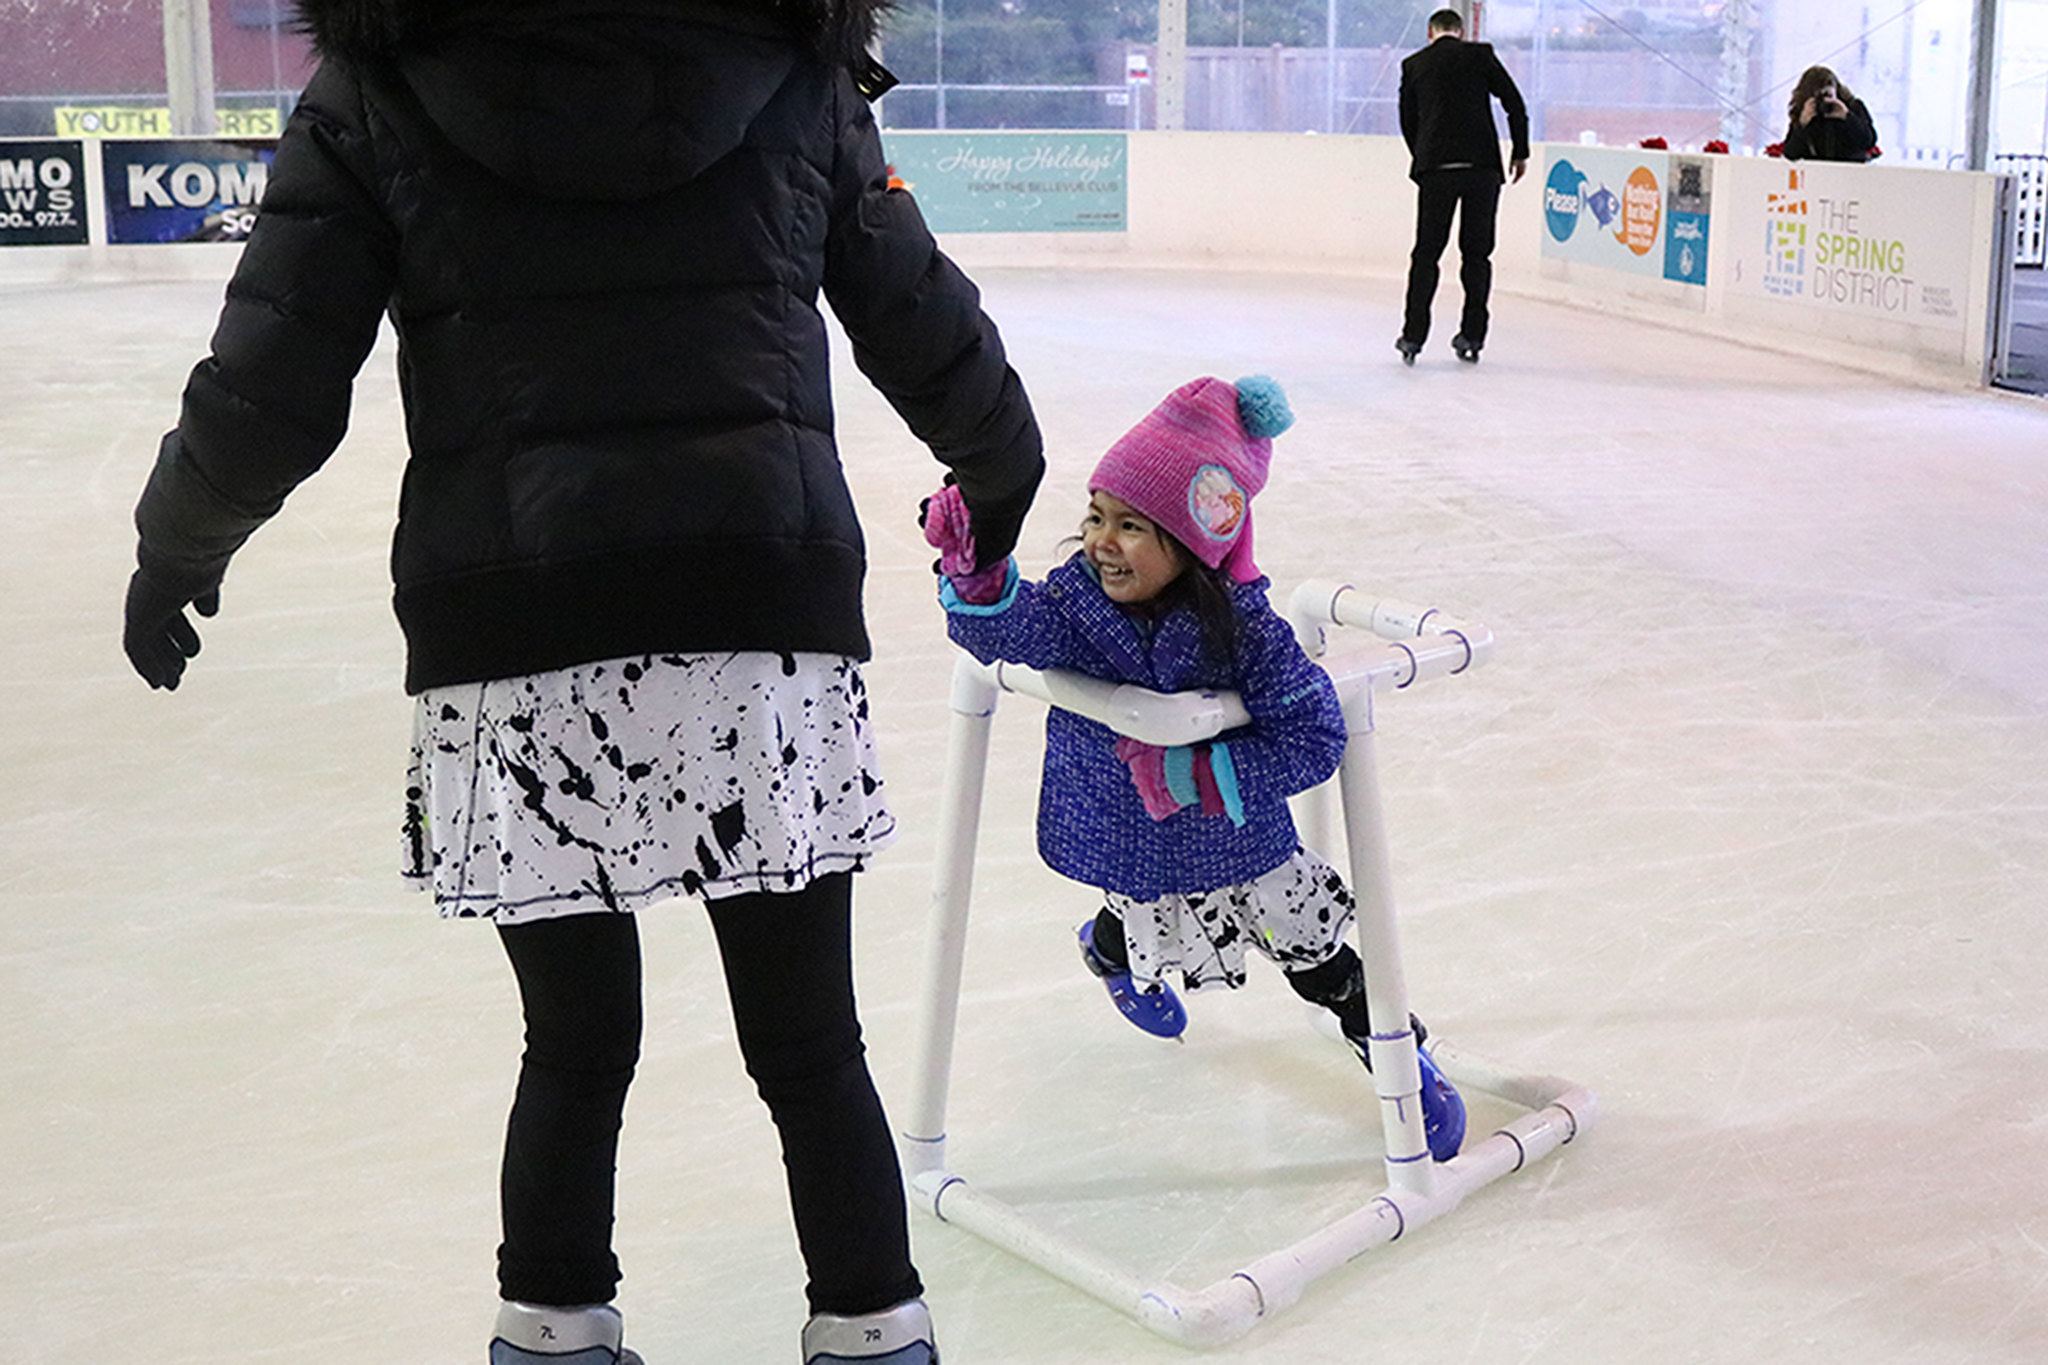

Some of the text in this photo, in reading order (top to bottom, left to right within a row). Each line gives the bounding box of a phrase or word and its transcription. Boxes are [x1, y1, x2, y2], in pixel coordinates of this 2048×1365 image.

[62, 111, 158, 134] YOUTH
[937, 145, 1123, 181] Happy Holidays!
[968, 181, 1119, 193] FROM THE BELLEVUE CLUB
[1819, 198, 1860, 234] THE
[1815, 232, 1905, 274] SPRING
[1813, 265, 1914, 313] DISTRICT
[541, 1325, 556, 1340] 7L
